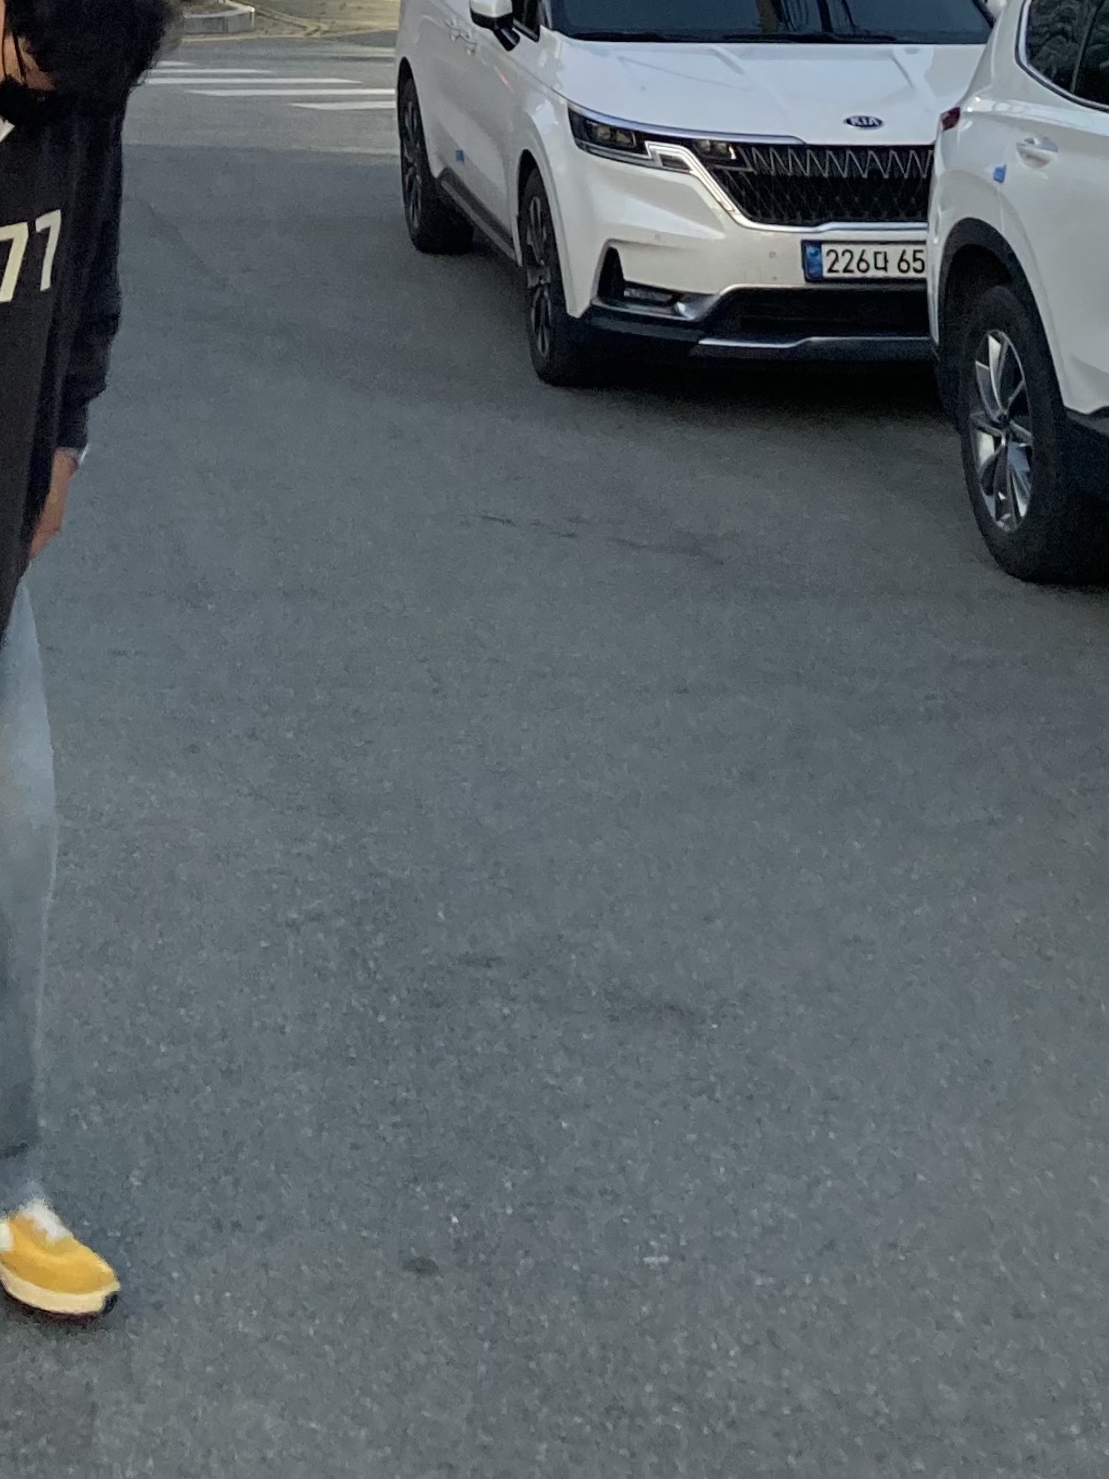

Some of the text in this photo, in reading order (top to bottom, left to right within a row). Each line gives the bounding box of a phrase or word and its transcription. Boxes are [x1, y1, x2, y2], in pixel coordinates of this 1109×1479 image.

[849, 116, 881, 127] KIA
[826, 249, 925, 274] 226다 65
